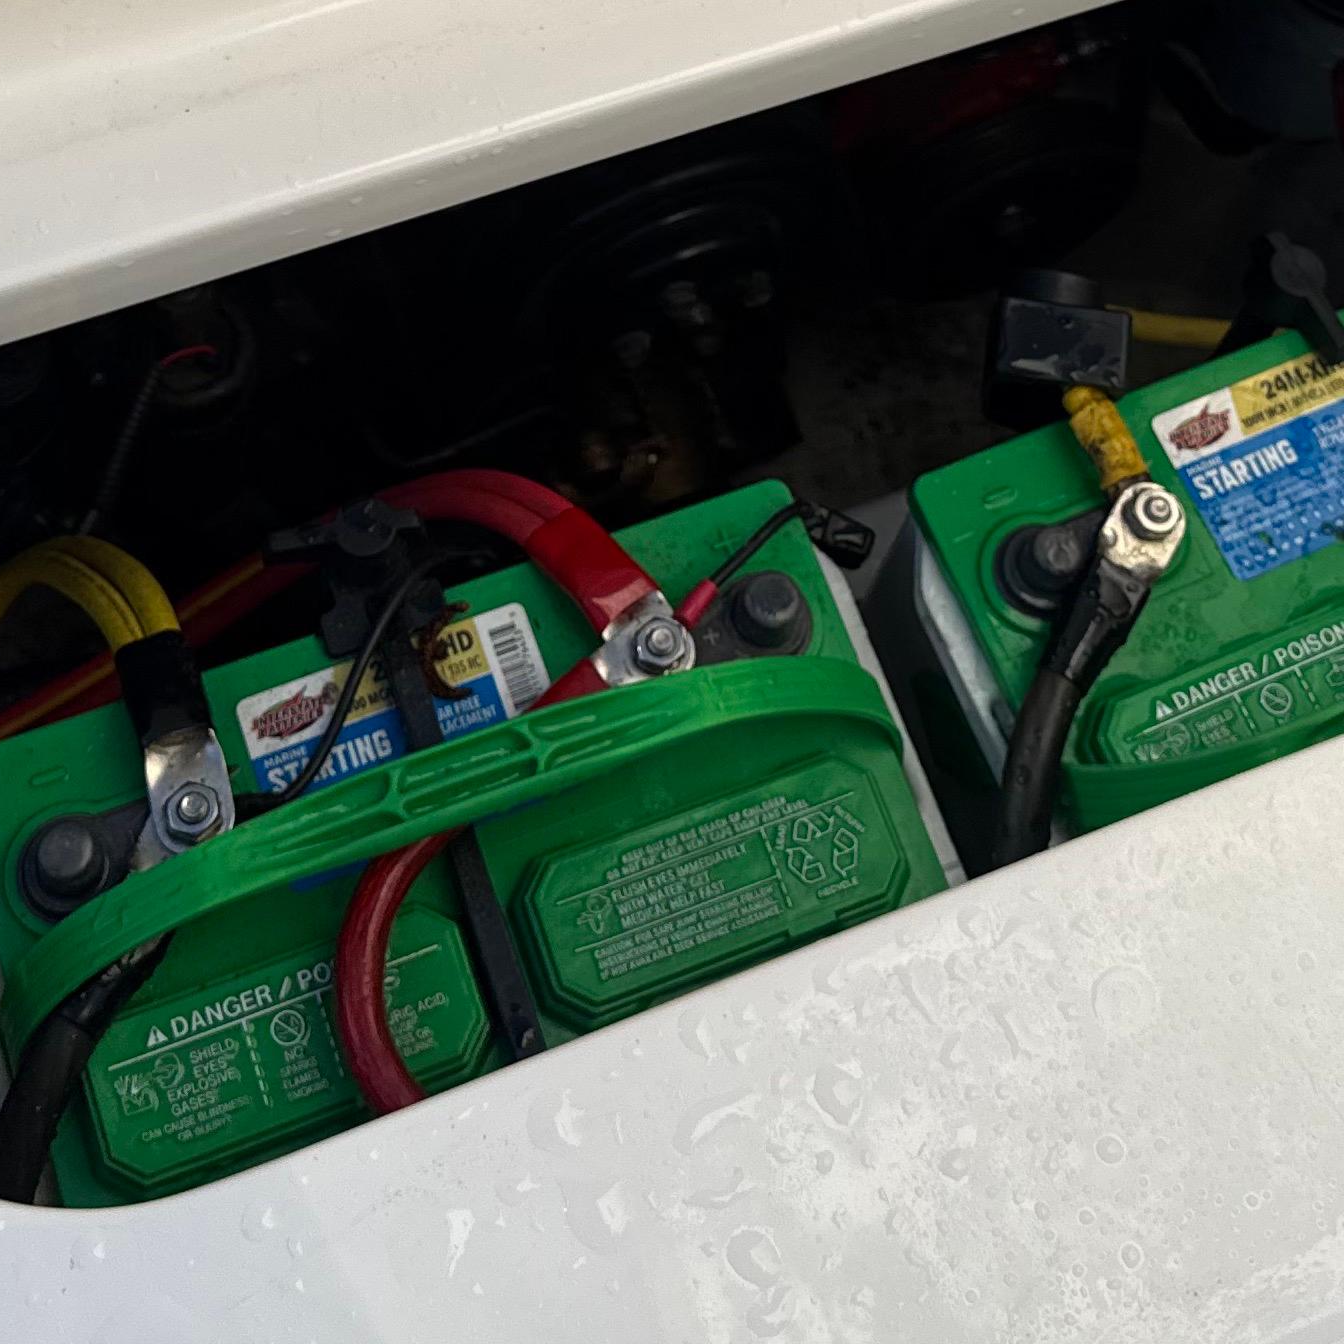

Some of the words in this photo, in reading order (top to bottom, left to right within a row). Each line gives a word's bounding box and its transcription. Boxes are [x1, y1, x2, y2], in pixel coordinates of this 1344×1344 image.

[1192, 438, 1298, 501] STARTING
[1171, 661, 1258, 711] DANGER
[251, 694, 324, 732] INTERSTATE
[439, 704, 497, 736] LACEMENT
[267, 729, 393, 794] STRTING
[611, 879, 648, 904] FLUSH
[646, 868, 677, 890] EYES
[675, 843, 748, 877] IMMEDIATELY
[617, 893, 647, 916] WITH
[688, 869, 711, 888] GET
[620, 901, 671, 929] MEDICAL
[669, 890, 698, 910] HELP
[698, 879, 726, 899] FAST
[170, 984, 273, 1038] DANGER
[190, 1038, 236, 1065] SHIELD
[193, 1056, 227, 1079] EYES
[167, 1067, 240, 1103] EXPLOSIVE
[171, 1090, 218, 1117] GASES
[163, 1114, 196, 1135] CAUSE
